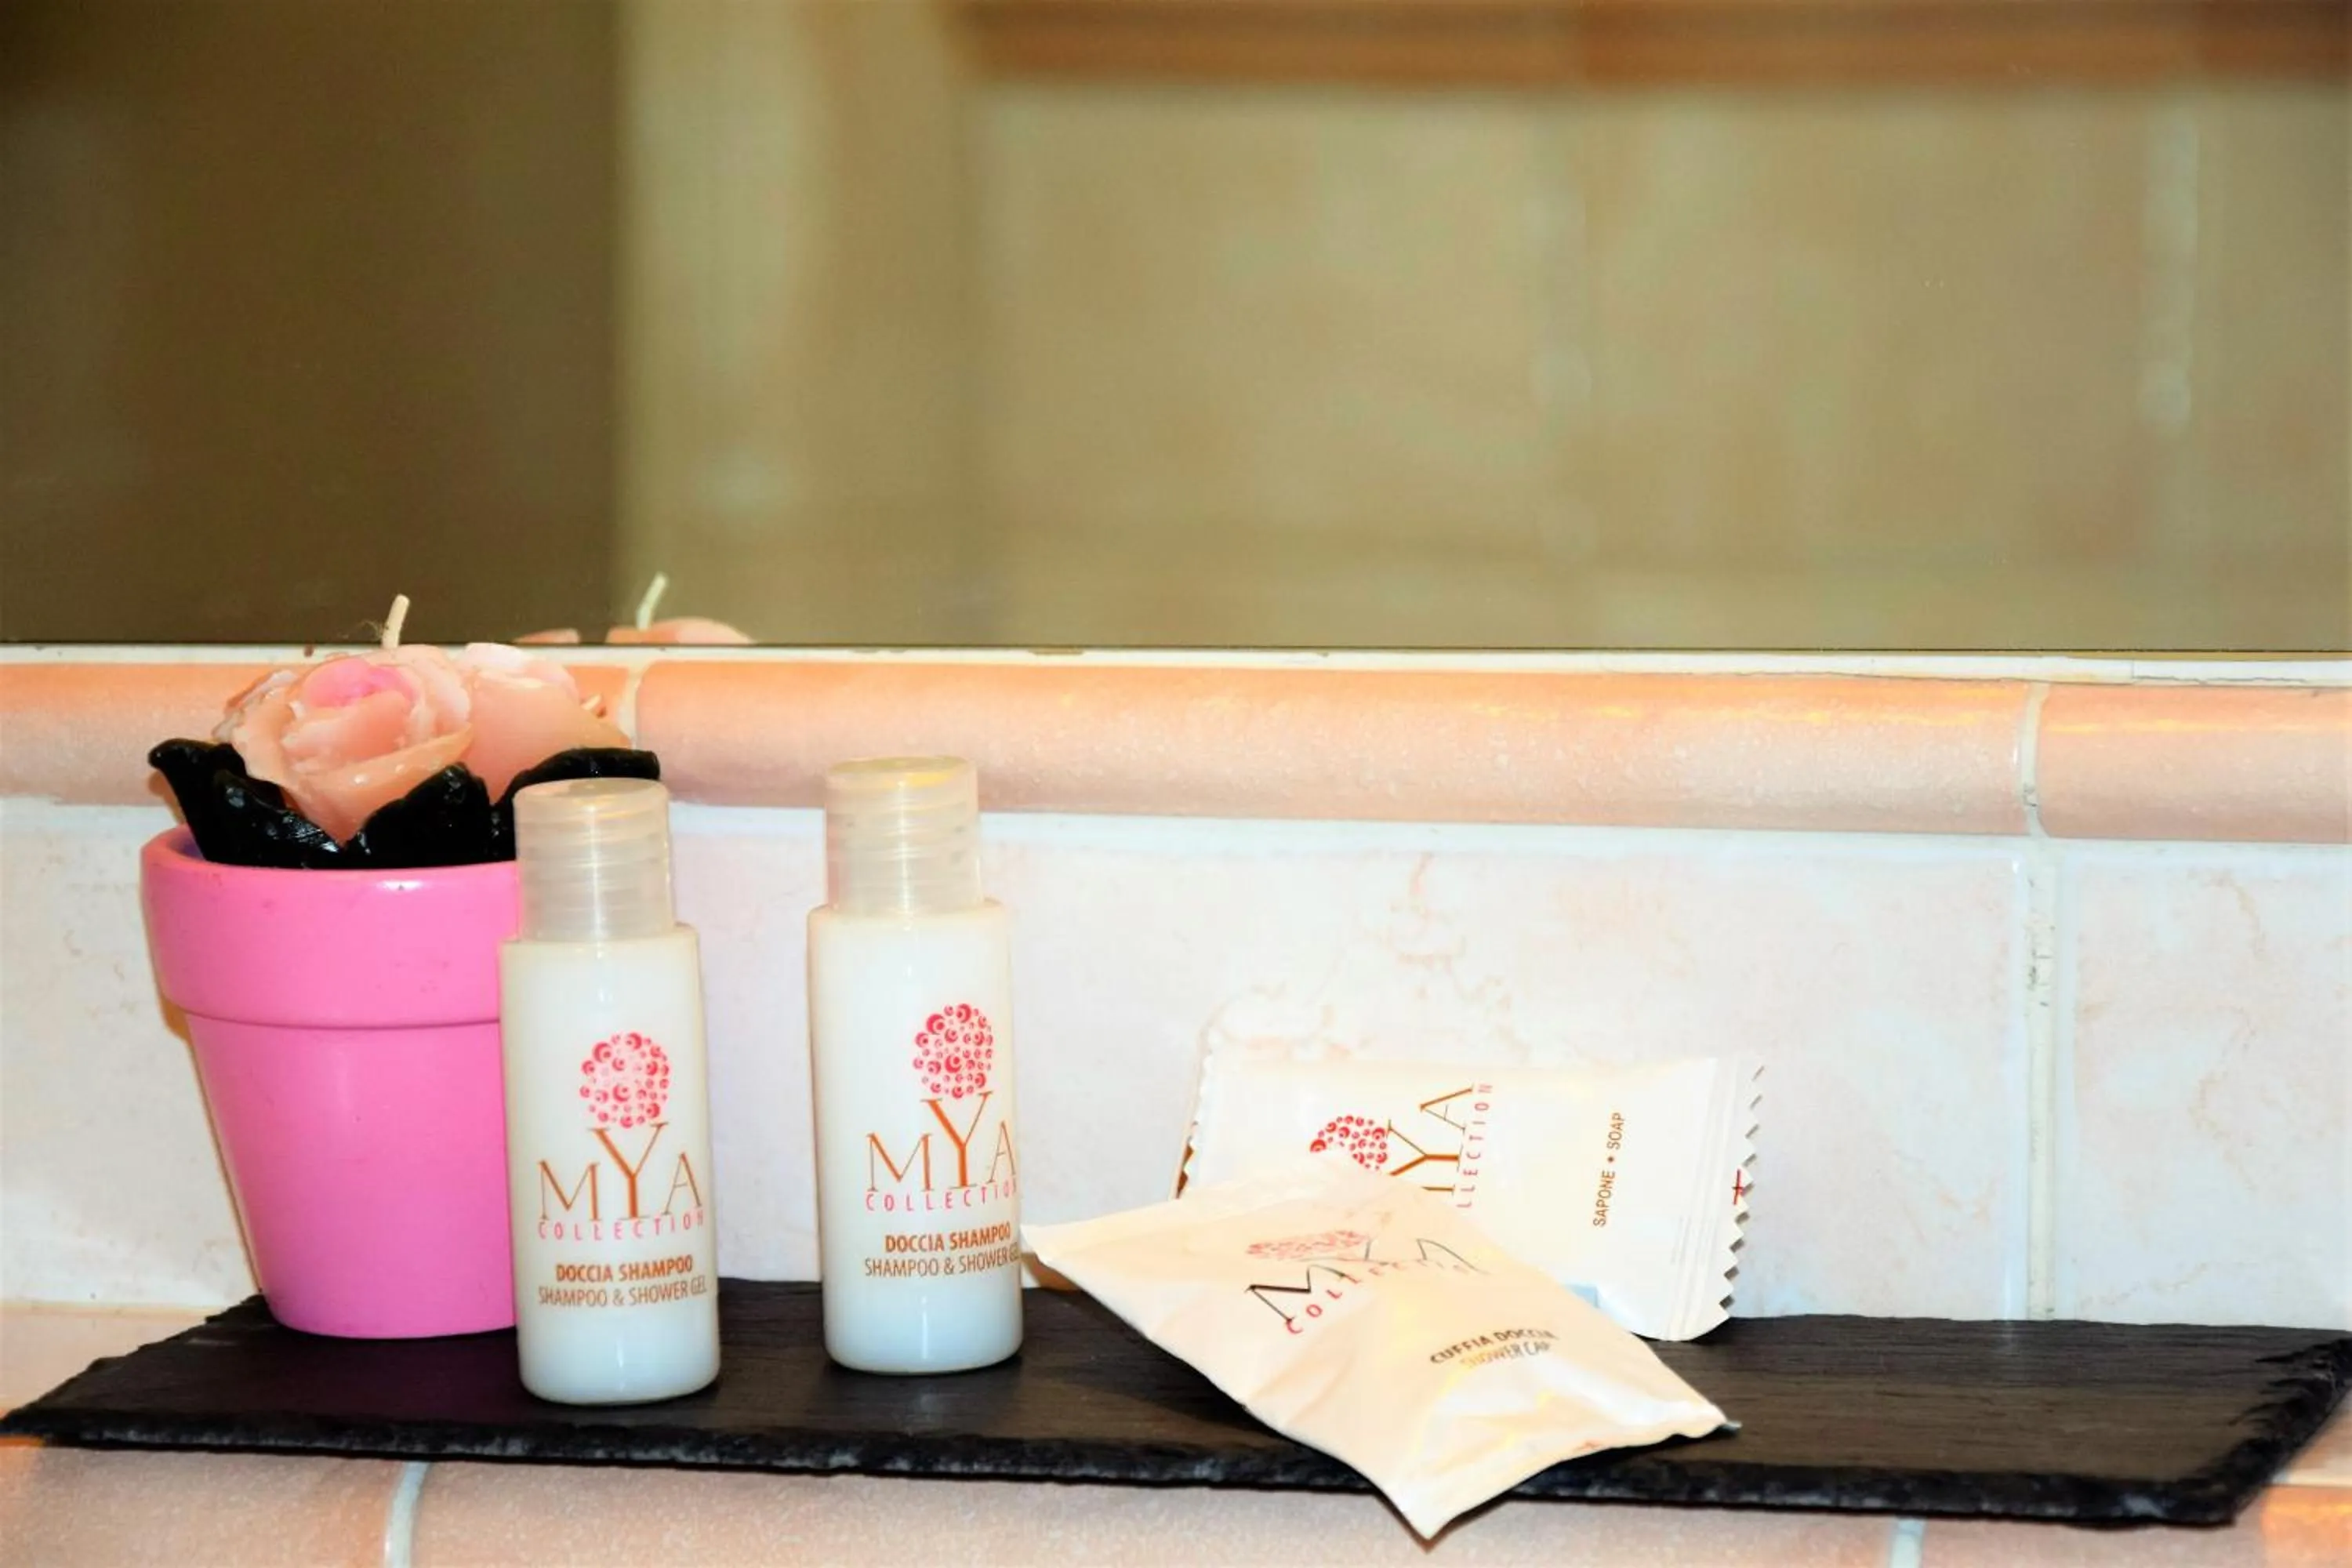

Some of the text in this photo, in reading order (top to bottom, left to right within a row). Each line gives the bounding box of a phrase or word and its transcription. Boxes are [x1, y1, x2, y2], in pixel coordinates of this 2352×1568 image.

[866, 1090, 1016, 1192] MYA
[1385, 1084, 1474, 1196] YA
[1456, 1083, 1494, 1209] LLECTION
[537, 1121, 702, 1221] MYA
[1592, 1112, 1626, 1228] SAPONE SOAP
[537, 1209, 704, 1241] COLLECTION
[884, 1221, 1011, 1254] DOCCIA SHAMPOO
[555, 1254, 693, 1283] DOCCIA SHAMPOO
[865, 1257, 939, 1277] SHAMPOO
[943, 1256, 955, 1276] &
[959, 1245, 1008, 1274] SHOWER
[538, 1274, 707, 1307] SHAMPOO & SHOWER GEL
[1429, 1334, 1494, 1364] CUFFIA
[1459, 1340, 1551, 1368] SHOWER CAP
